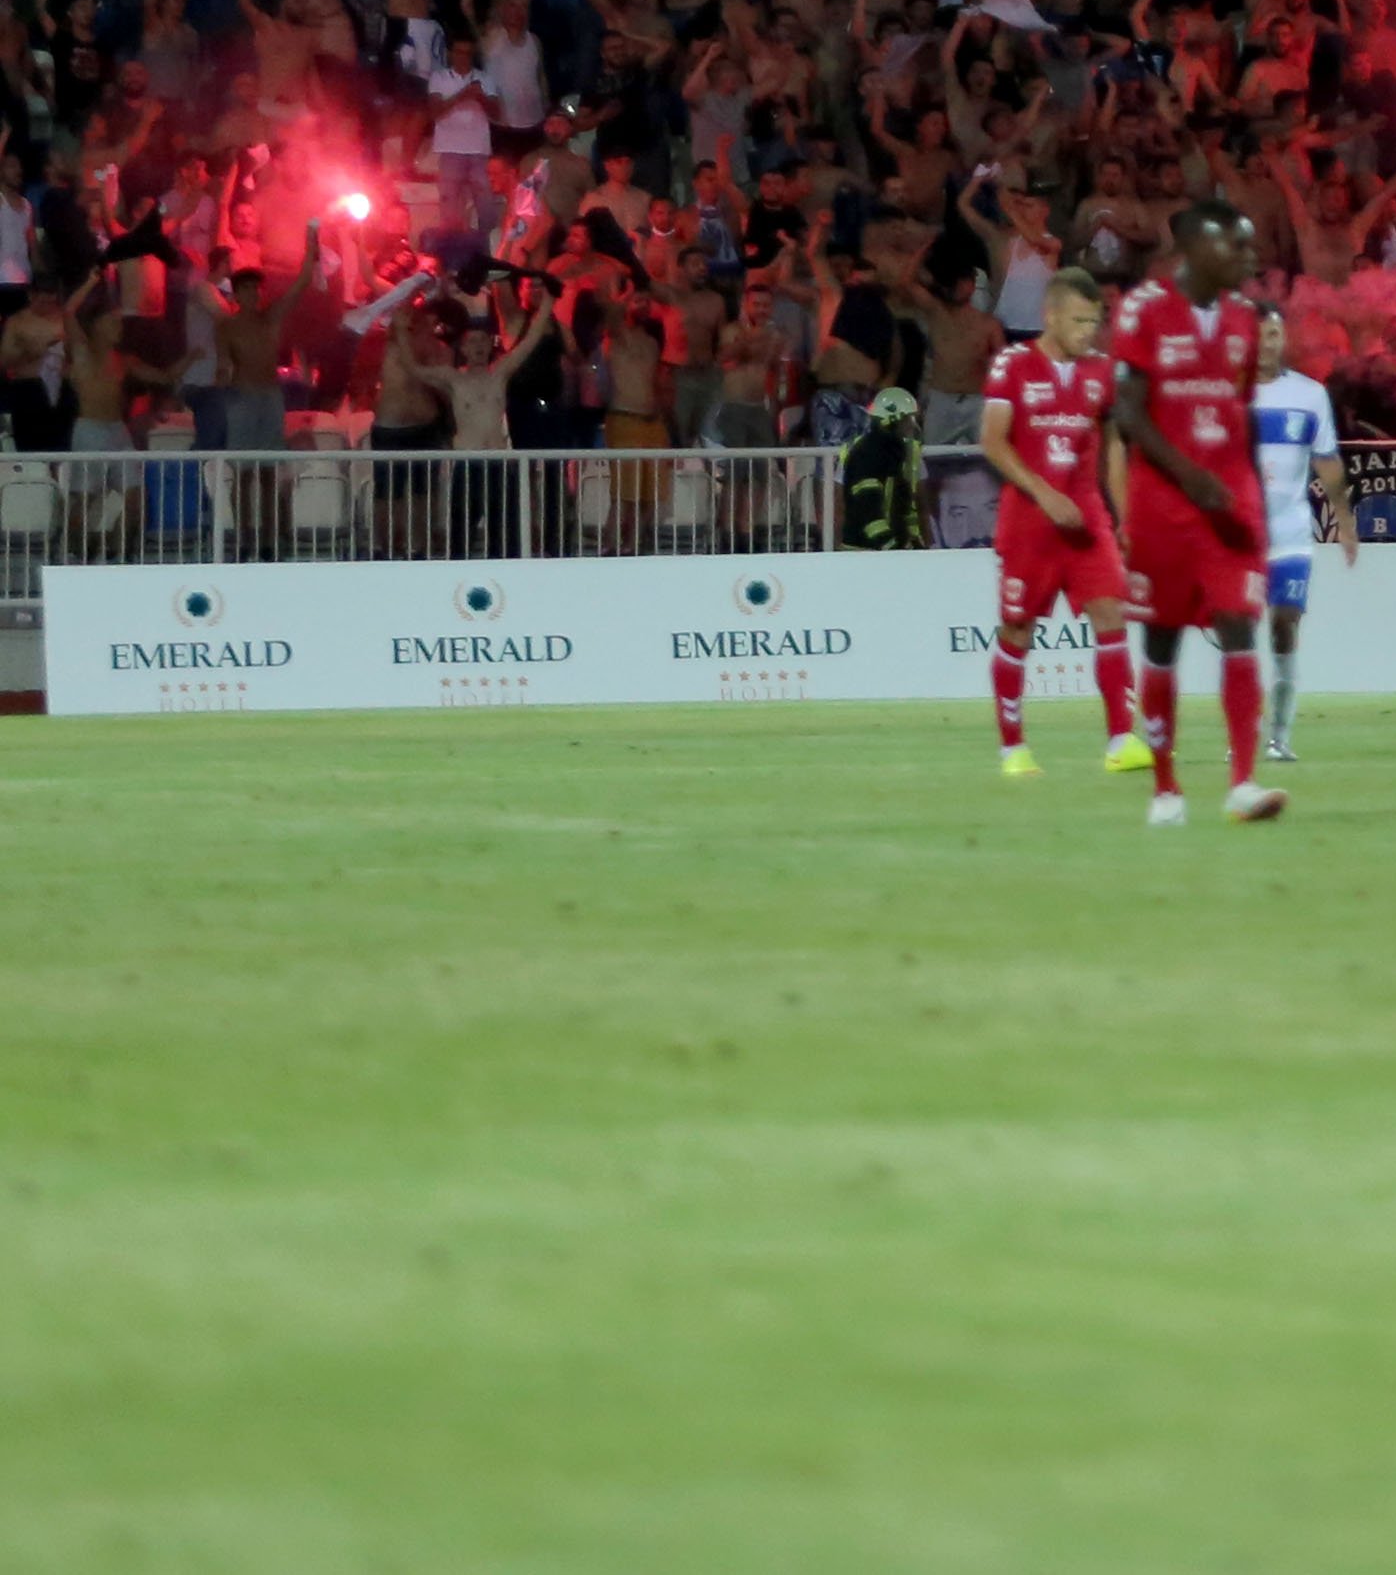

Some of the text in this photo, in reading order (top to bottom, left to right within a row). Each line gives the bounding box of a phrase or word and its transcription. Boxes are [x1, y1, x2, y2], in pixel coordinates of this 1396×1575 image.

[1372, 516, 1388, 534] B
[391, 634, 573, 664] EMERALD
[671, 628, 852, 659] EMERALD
[948, 622, 1096, 653] EMRAL
[110, 639, 293, 670] EMERALD
